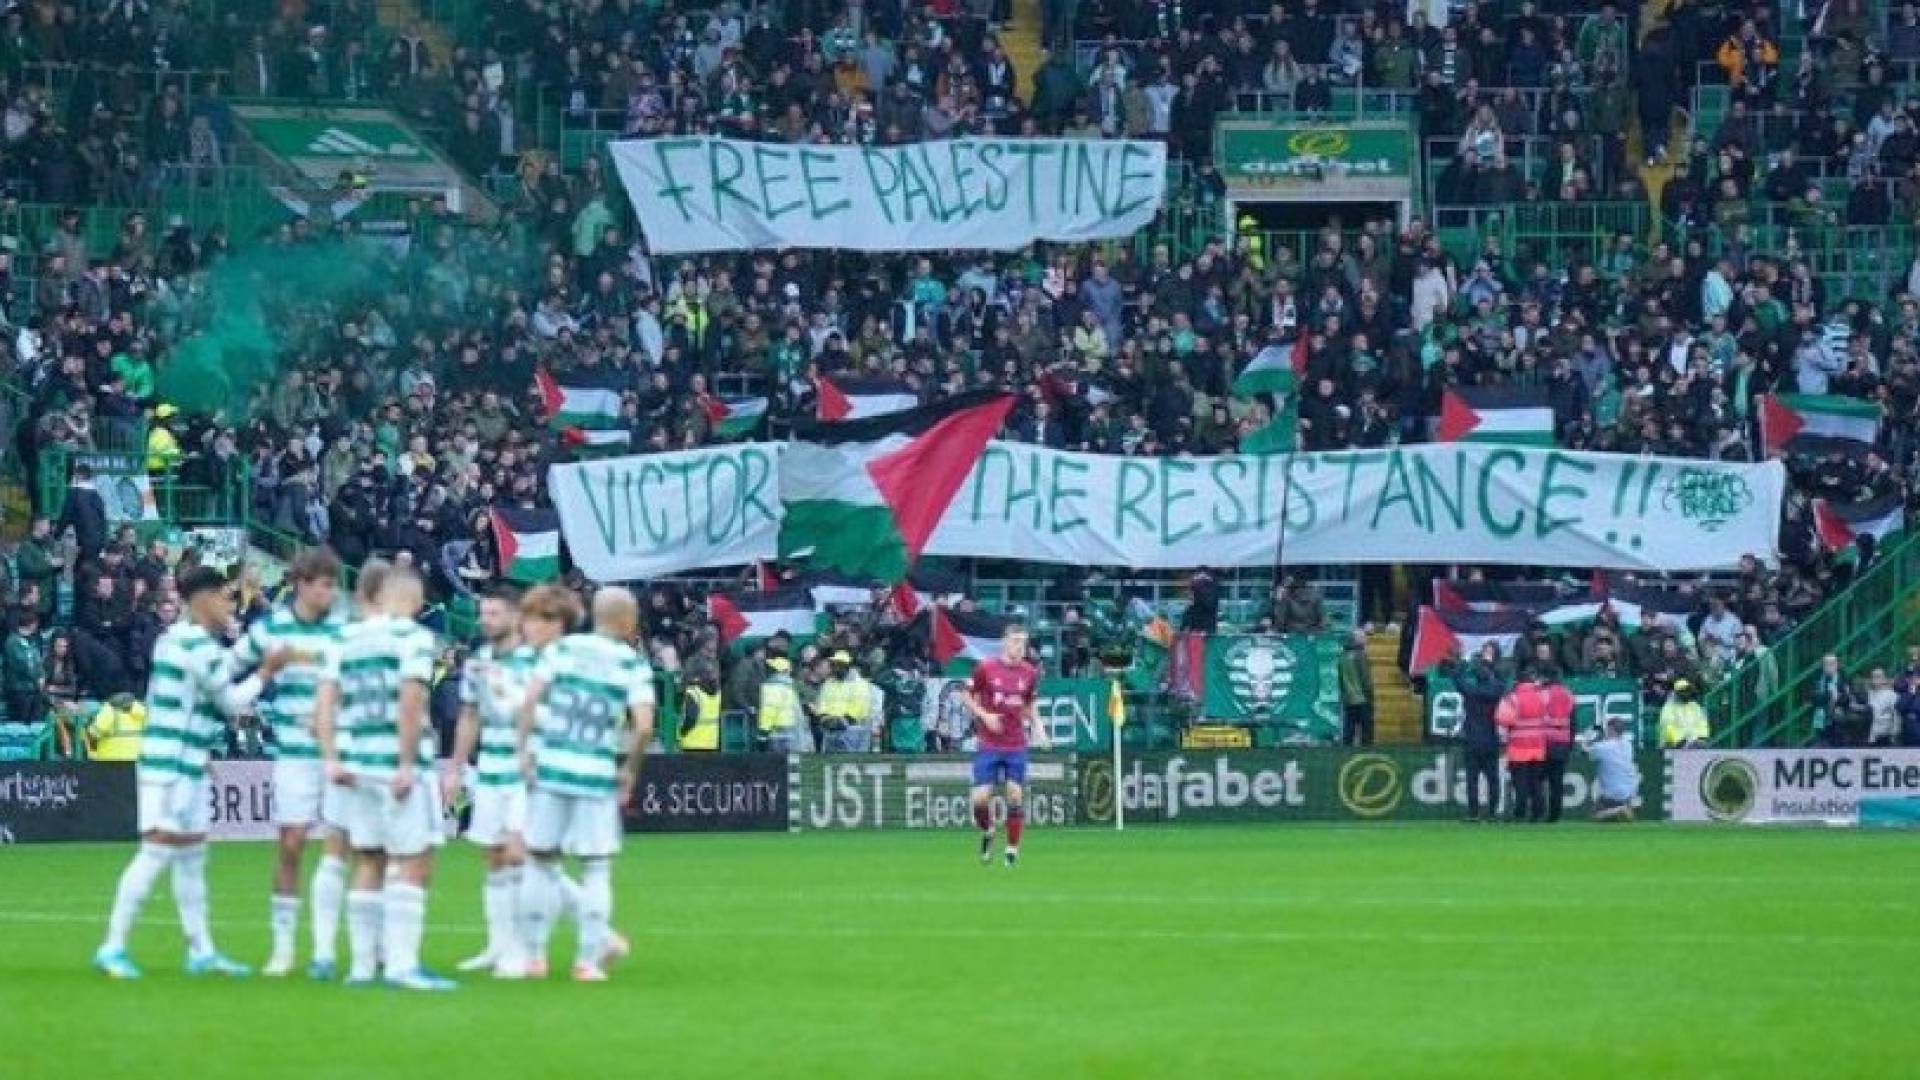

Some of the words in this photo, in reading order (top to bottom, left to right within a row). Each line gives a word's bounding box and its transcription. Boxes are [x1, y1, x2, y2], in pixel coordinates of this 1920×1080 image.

[653, 140, 851, 222] FREE
[862, 141, 1156, 224] PALESTINE
[578, 449, 780, 556] VICTOR
[1116, 449, 1596, 547] RESISTANCE
[643, 783, 662, 814] &
[668, 783, 780, 815] SECURITY
[810, 762, 892, 828] JST
[1121, 753, 1305, 819] dafabet
[1774, 758, 1852, 789] MPC
